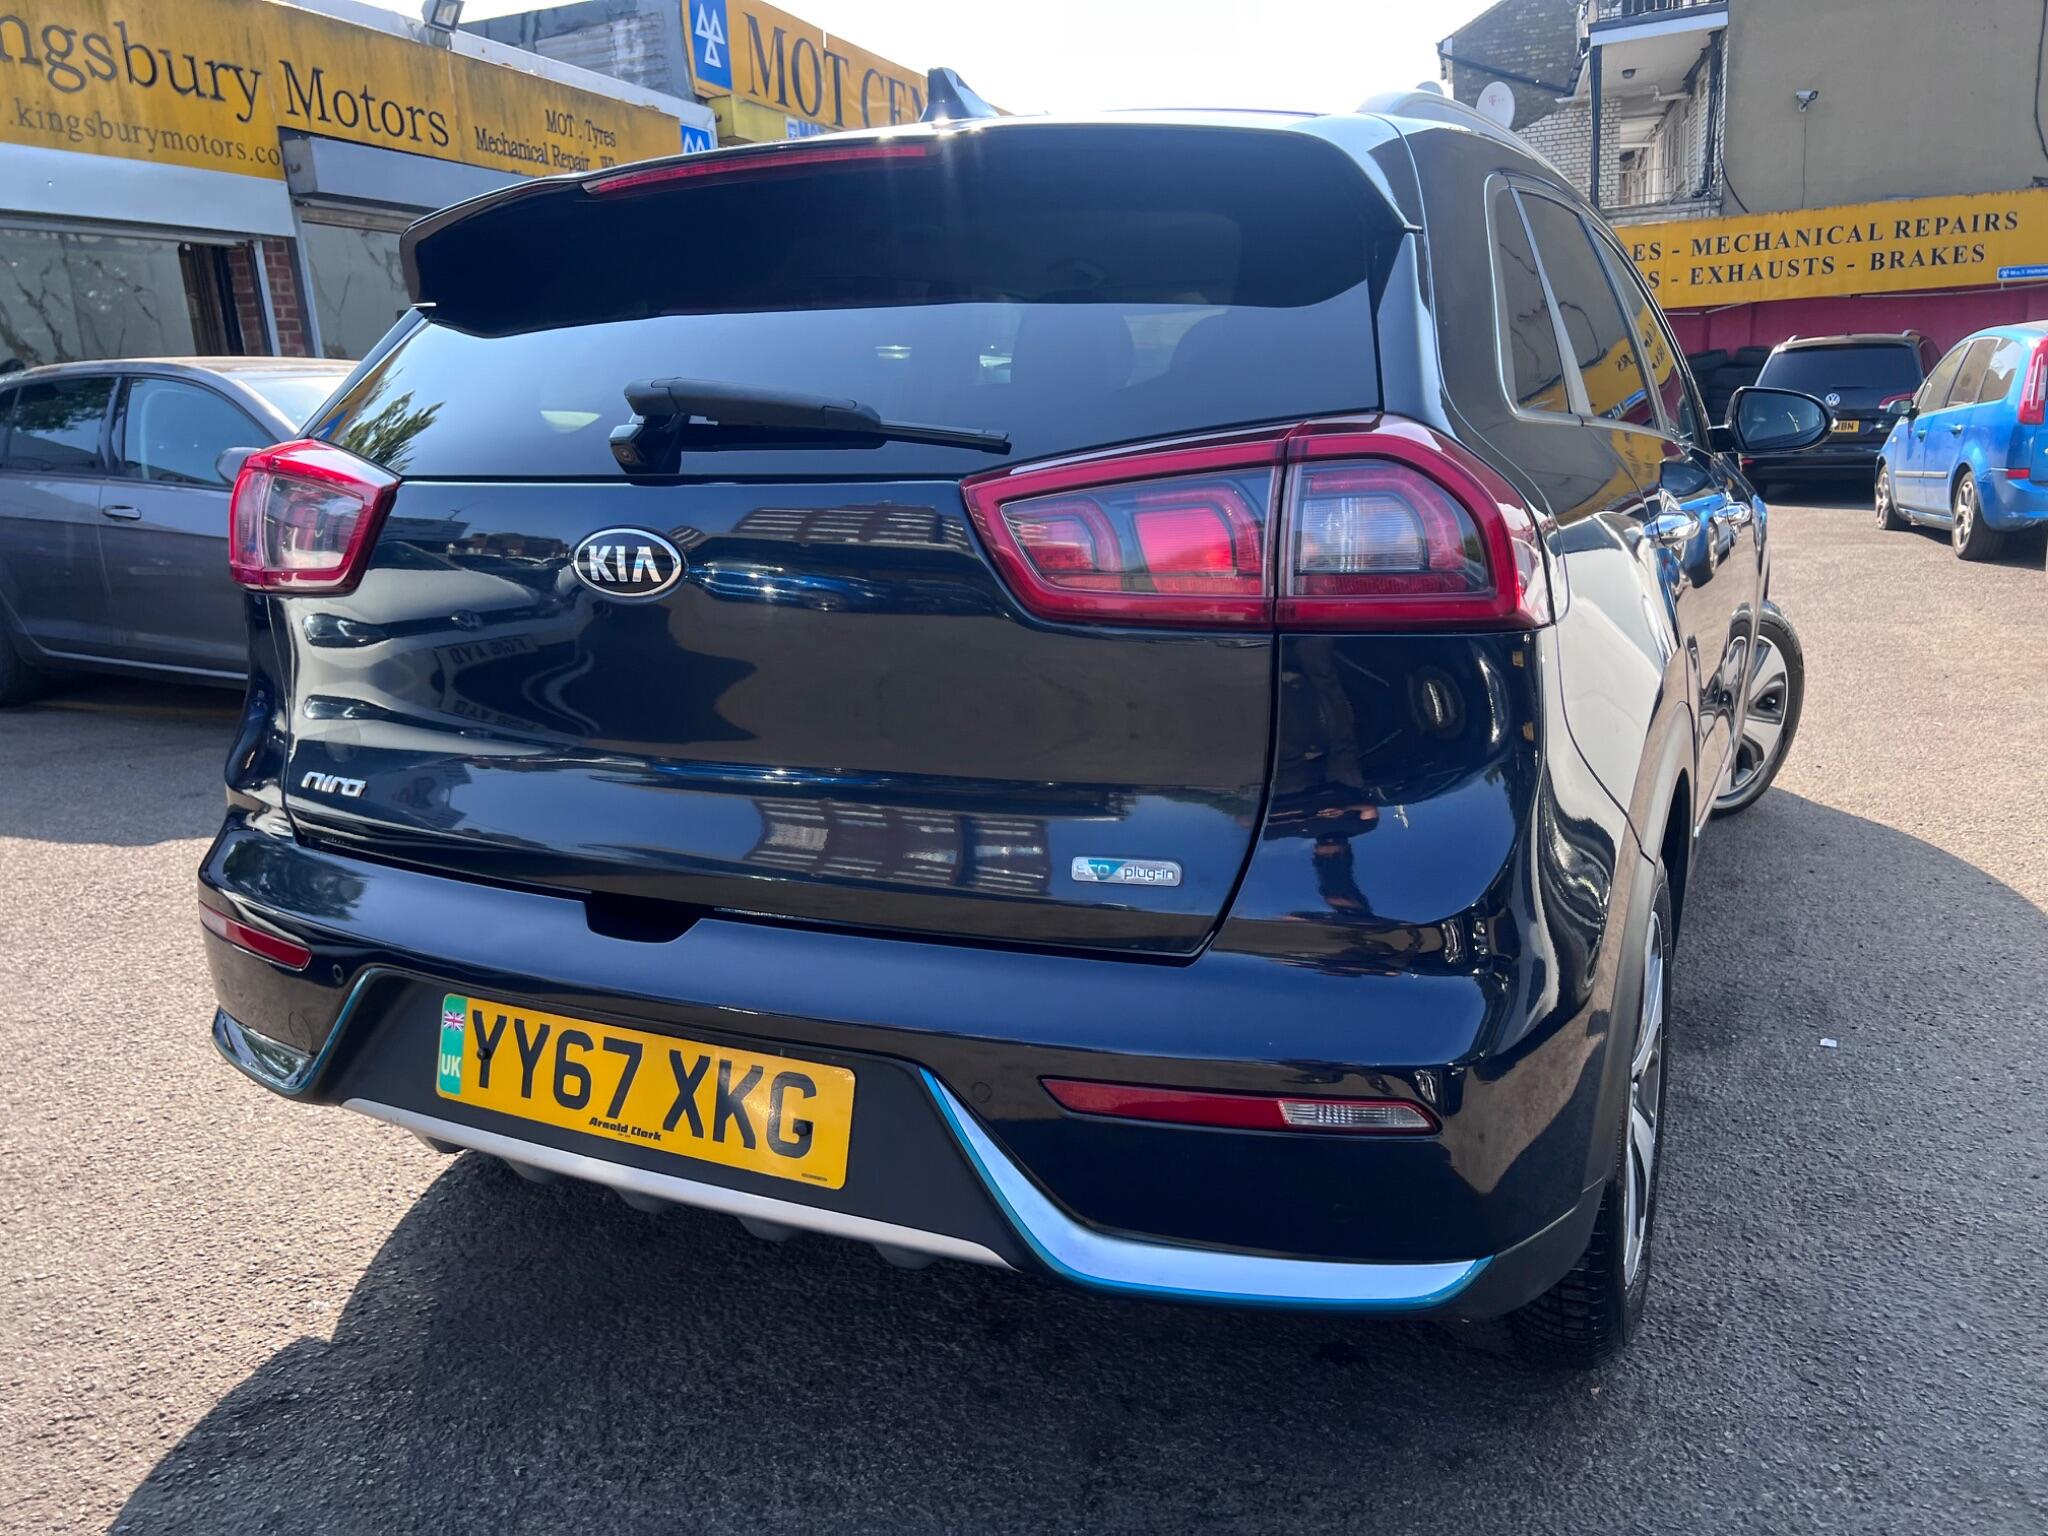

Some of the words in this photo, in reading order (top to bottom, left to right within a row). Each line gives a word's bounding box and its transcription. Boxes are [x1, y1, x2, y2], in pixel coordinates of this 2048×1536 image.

[743, 11, 849, 128] MOT
[279, 60, 450, 147] Motors
[474, 126, 550, 166] Mechanical
[545, 109, 575, 138] MOT
[585, 119, 617, 148] Tyres
[1691, 222, 1884, 257] MECHANICAL
[1894, 211, 2019, 240] REPAIRS
[1690, 256, 1834, 285] EXHAUSTS
[1870, 243, 1985, 271] BRAKES
[588, 545, 662, 583] KIA
[1124, 865, 1176, 881] plug-in
[440, 1052, 461, 1078] UK
[472, 1009, 644, 1119] YY67
[662, 1049, 817, 1159] XKG
[589, 1116, 629, 1133] Arnold
[631, 1126, 662, 1141] Clark
